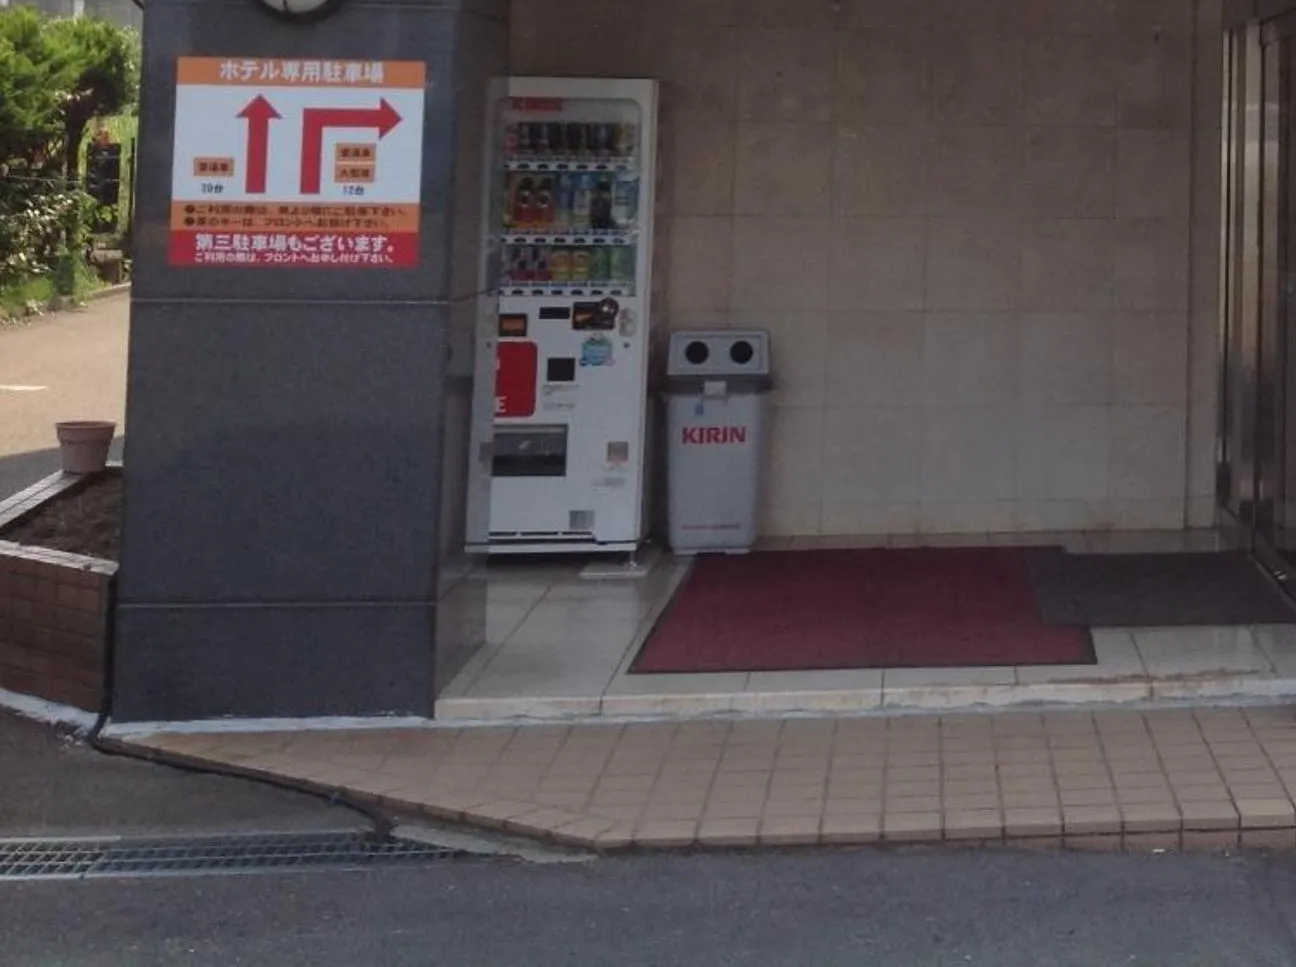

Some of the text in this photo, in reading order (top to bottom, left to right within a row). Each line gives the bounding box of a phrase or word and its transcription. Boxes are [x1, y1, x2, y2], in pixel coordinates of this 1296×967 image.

[219, 60, 385, 84] ホテル専用駐車場
[195, 233, 395, 252] 第三駐車場もございます。
[682, 426, 747, 445] KIRIN
